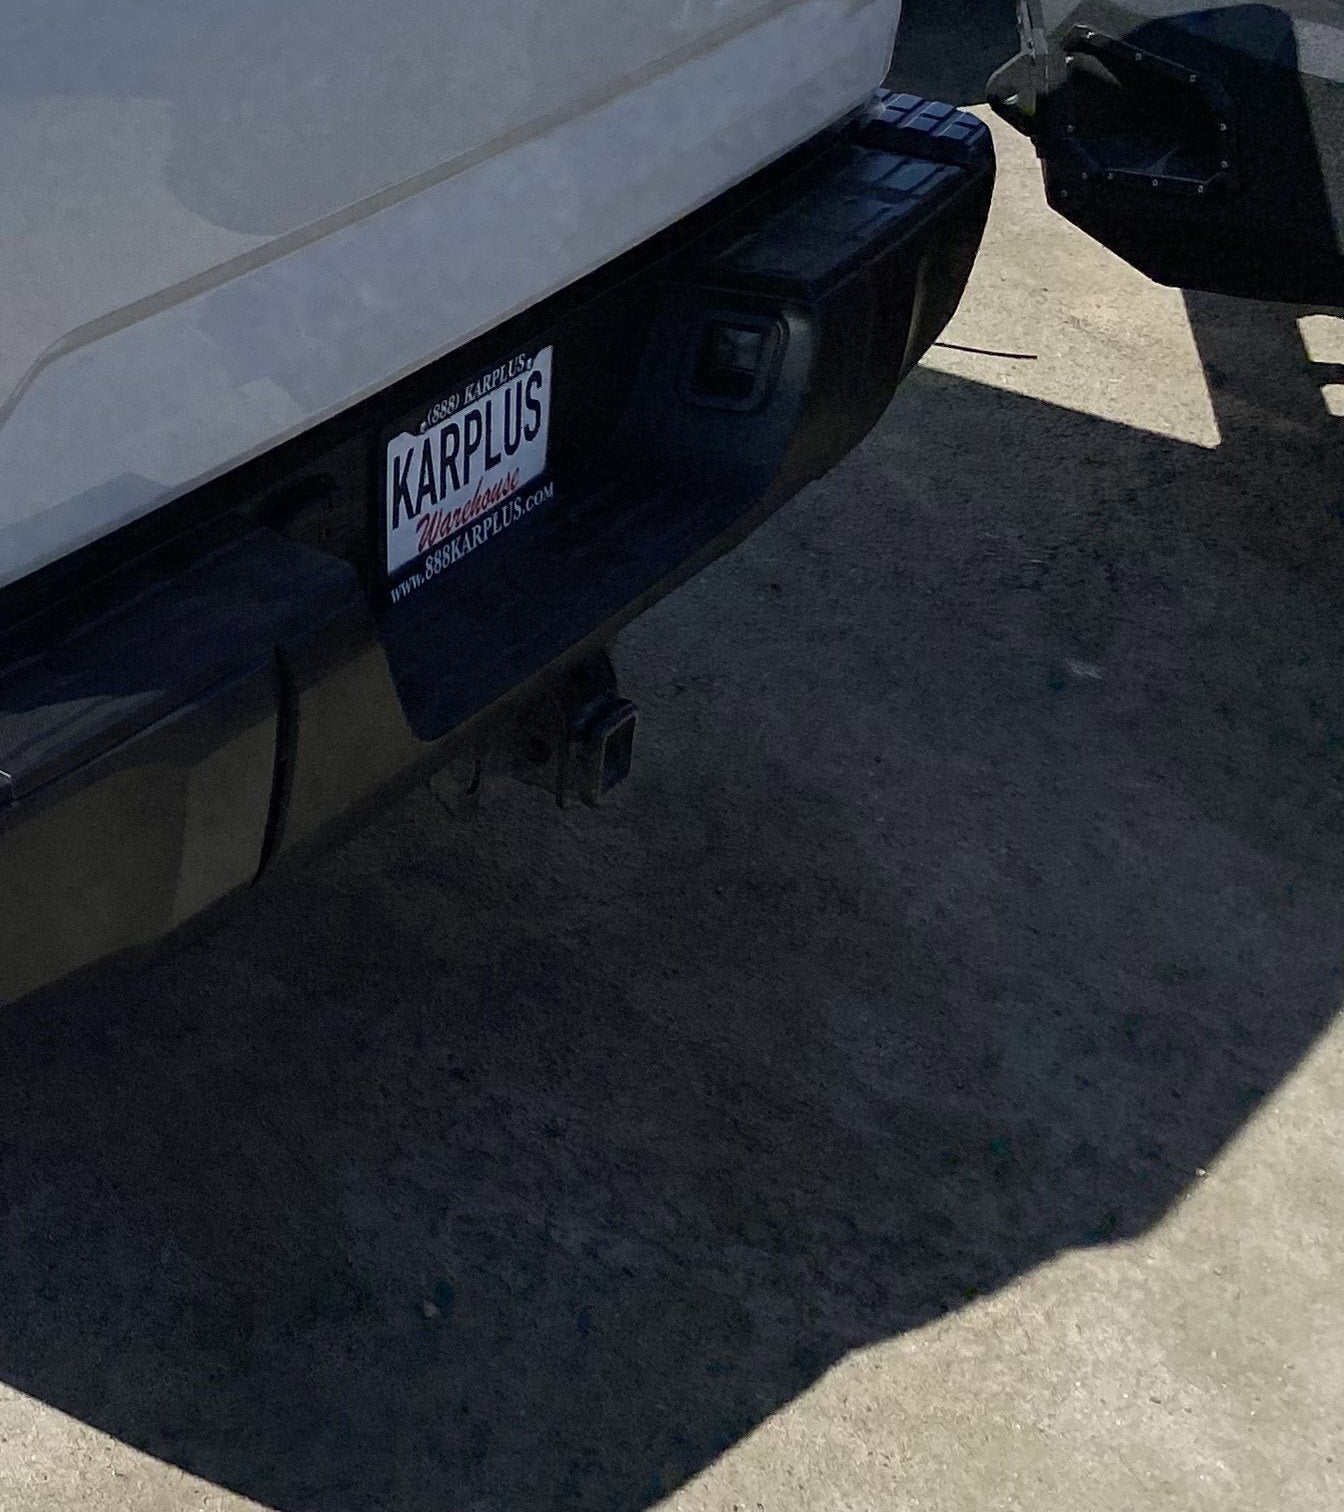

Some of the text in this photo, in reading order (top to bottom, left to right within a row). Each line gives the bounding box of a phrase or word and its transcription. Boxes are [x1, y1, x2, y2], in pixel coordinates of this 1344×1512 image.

[426, 352, 527, 425] (888) KARPLUS
[392, 370, 542, 530] KARPLUS
[415, 467, 520, 552] Warehouse
